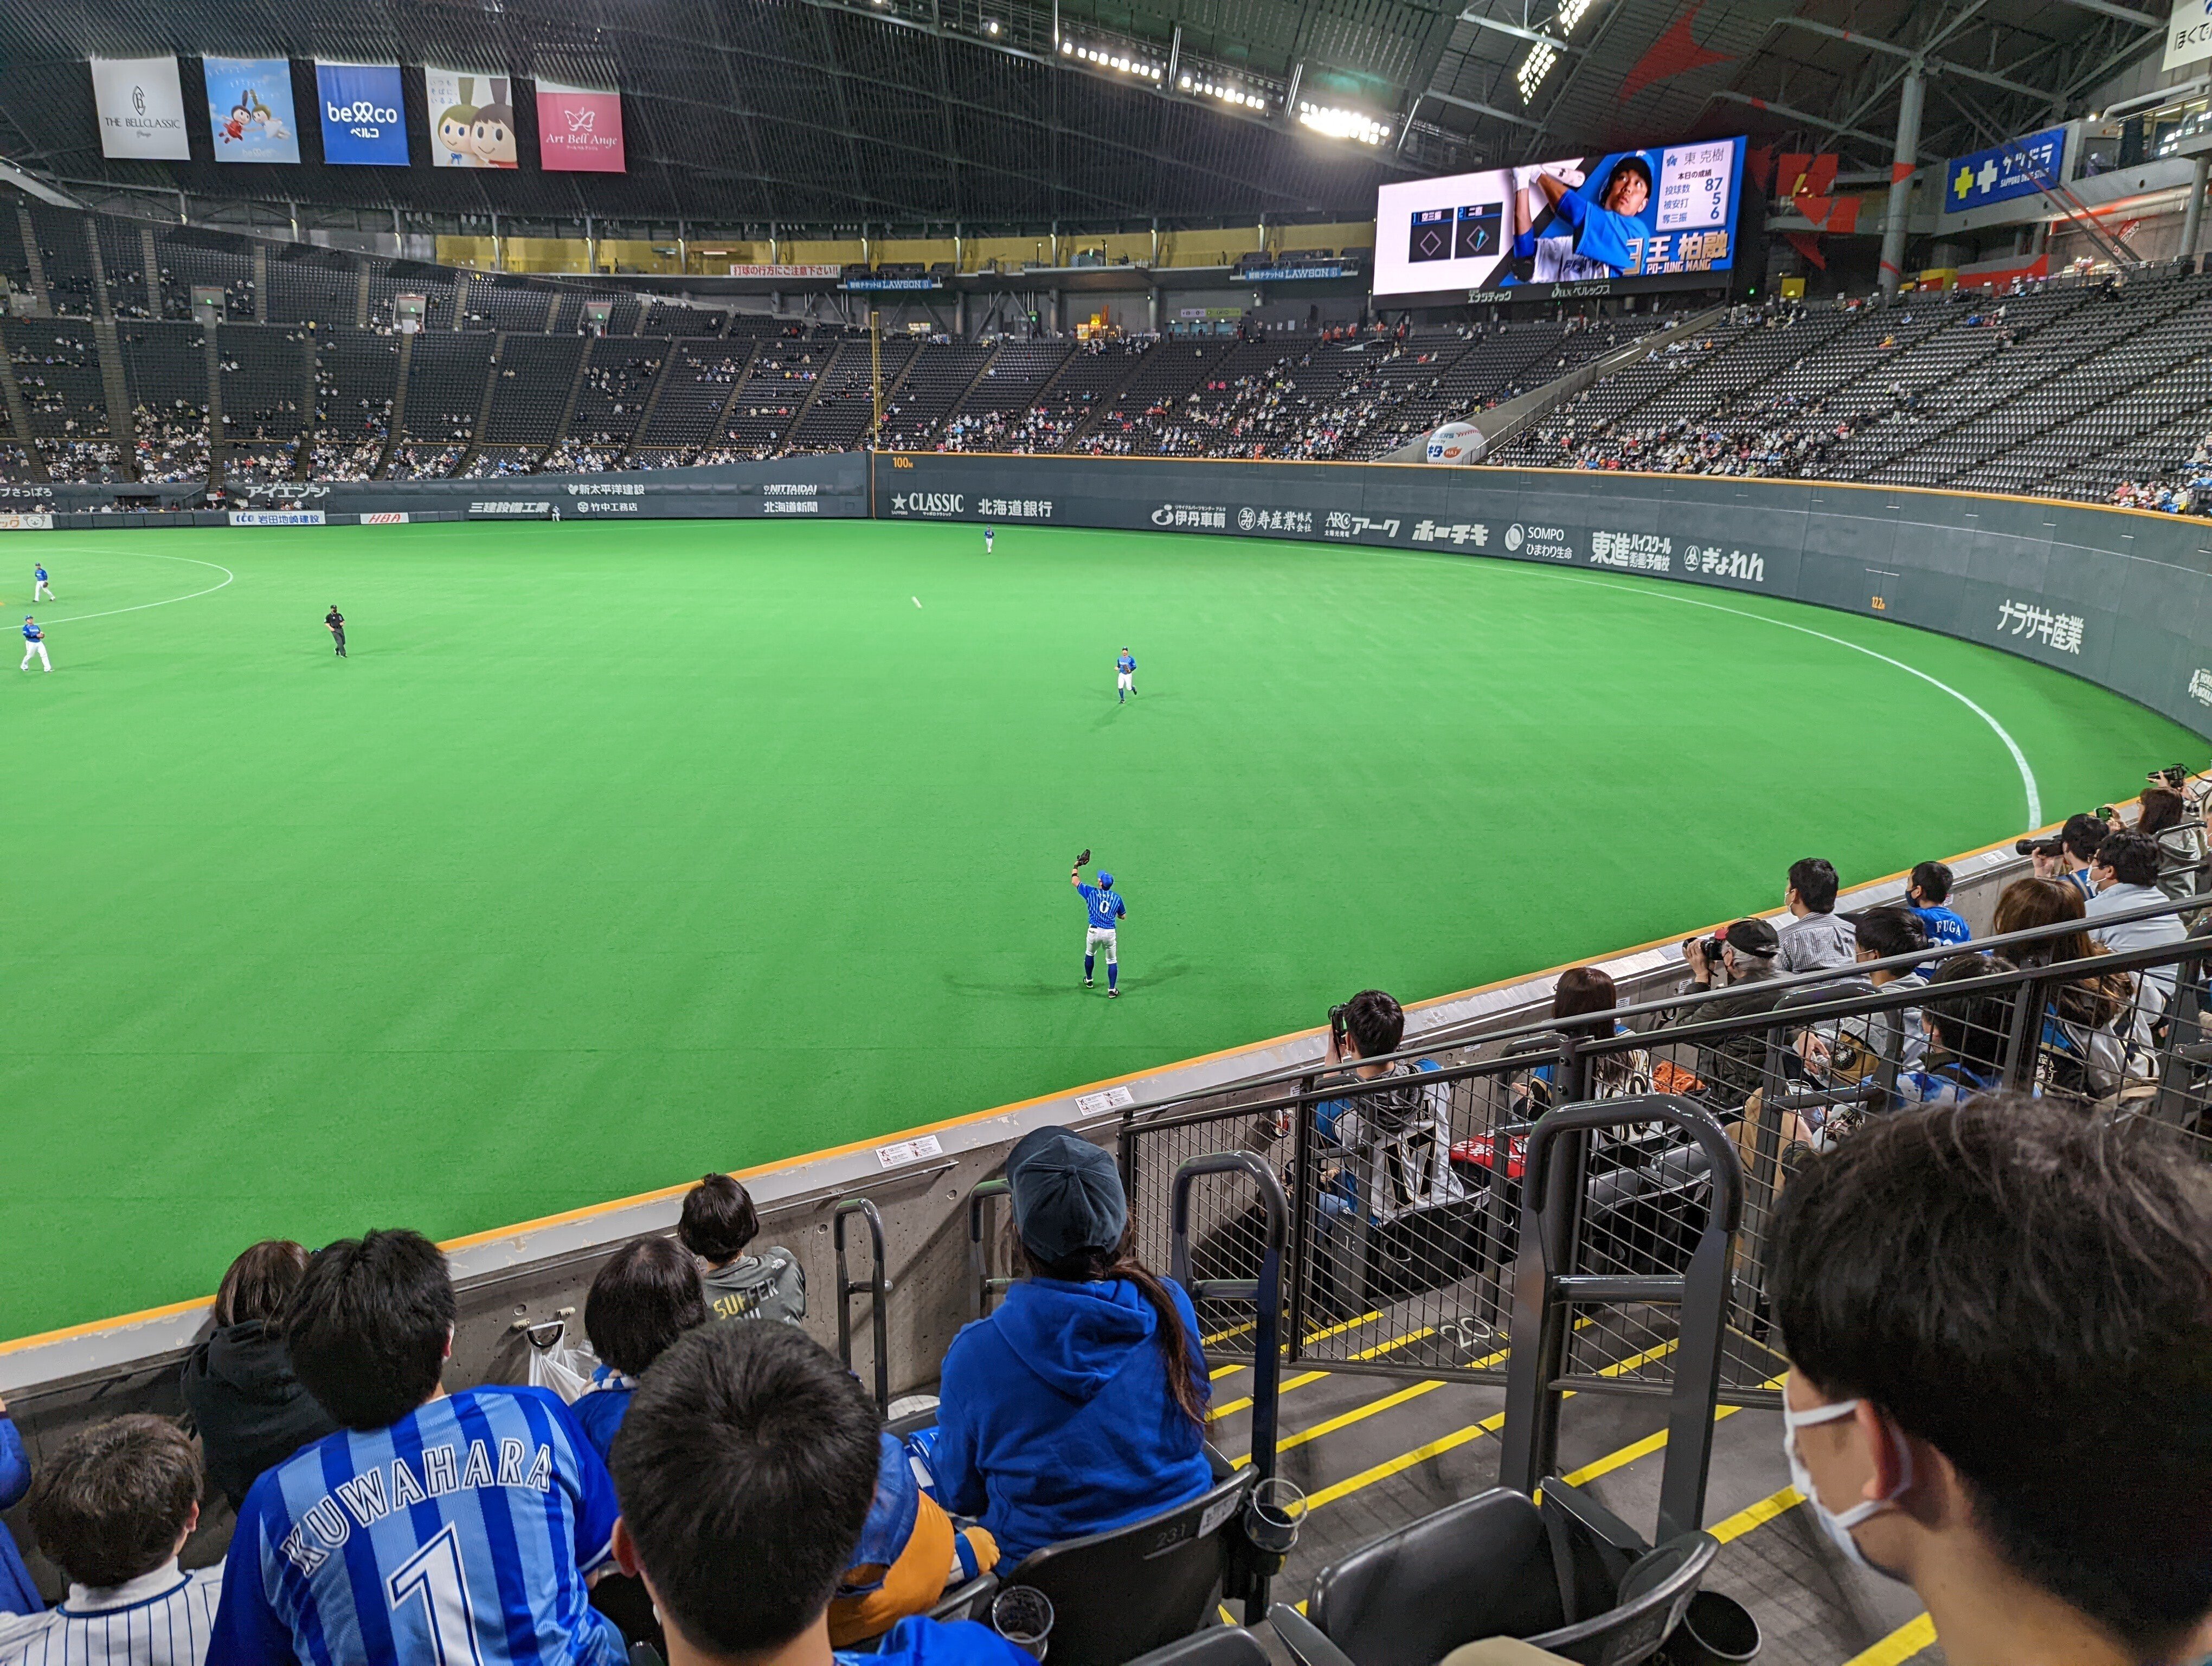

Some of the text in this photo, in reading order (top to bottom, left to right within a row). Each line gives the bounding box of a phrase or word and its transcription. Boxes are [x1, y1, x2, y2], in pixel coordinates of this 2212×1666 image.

[105, 117, 181, 129] THE BELLCLASSIC
[350, 127, 380, 138] ベルコ
[545, 133, 618, 149] Art Bell Ange
[1683, 151, 1697, 165] 東
[1677, 169, 1712, 180] 本日の成績
[1664, 177, 1723, 196] 投球数 87
[1663, 191, 1721, 210] 被安打 5
[1710, 206, 1720, 220] 6
[1646, 235, 1671, 263] 王
[1285, 268, 1328, 278] LAWSON
[1647, 258, 1711, 275] PO-JUNG WANG
[883, 280, 921, 289] LAWSON
[1573, 285, 1610, 297] ベルックス
[579, 484, 645, 495] 新太平洋建設
[770, 484, 817, 495] NITTAIDAI
[469, 502, 550, 514] 三建設備工業
[590, 503, 638, 512] 竹中工務店
[764, 501, 818, 513] 北海道新聞
[909, 492, 964, 512] CLASSIC
[978, 498, 1052, 518] 北海道銀行
[258, 515, 320, 524] 岩田地崎建設
[1257, 510, 1297, 531] 寿産業
[1297, 512, 1312, 523] 株式
[1325, 511, 1351, 529] ARC
[1297, 523, 1311, 533] 会社
[1352, 517, 1400, 537] アーク
[1412, 520, 1489, 547] ホーチキ
[1527, 526, 1565, 541] SOMPO
[1526, 543, 1572, 560] ひまわり生命
[1590, 531, 1631, 567] 東進
[1630, 534, 1671, 555] ハイスクール
[1702, 547, 1764, 582] ぎょれん
[1997, 599, 2084, 655] ナラサキ産業
[1099, 900, 1110, 913] 0
[1935, 920, 1961, 937] FUGA
[280, 1437, 553, 1578] KUWAHARA
[386, 1520, 485, 1666] 1
